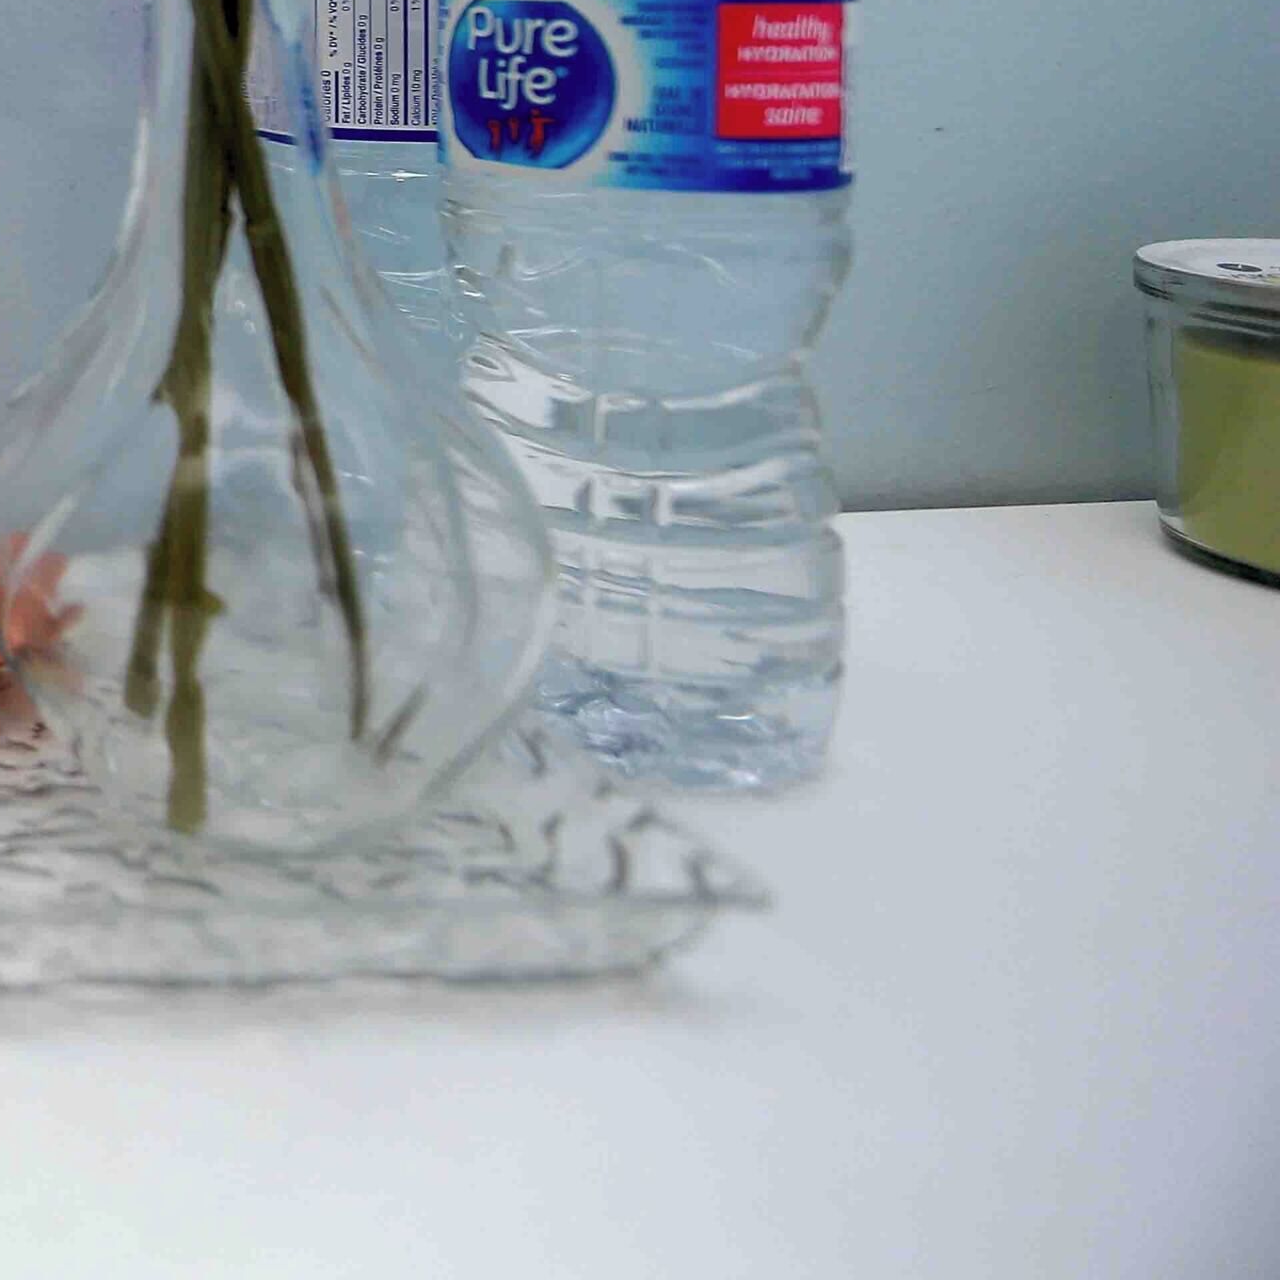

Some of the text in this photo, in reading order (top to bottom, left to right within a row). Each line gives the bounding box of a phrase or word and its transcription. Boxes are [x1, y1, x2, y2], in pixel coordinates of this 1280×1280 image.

[466, 5, 579, 58] Pure
[751, 14, 833, 46] healthy
[357, 29, 367, 64] Glucides
[373, 51, 383, 89] Protéines
[392, 73, 401, 86] mg
[413, 70, 422, 82] mg
[478, 55, 558, 110] Life
[341, 76, 352, 105] Lipides
[357, 70, 368, 125] Carbohydrate
[411, 83, 420, 93] 10
[341, 111, 351, 124] Fat
[373, 96, 383, 125] Protein
[390, 95, 400, 126] Sodium
[411, 95, 421, 126] Calcium
